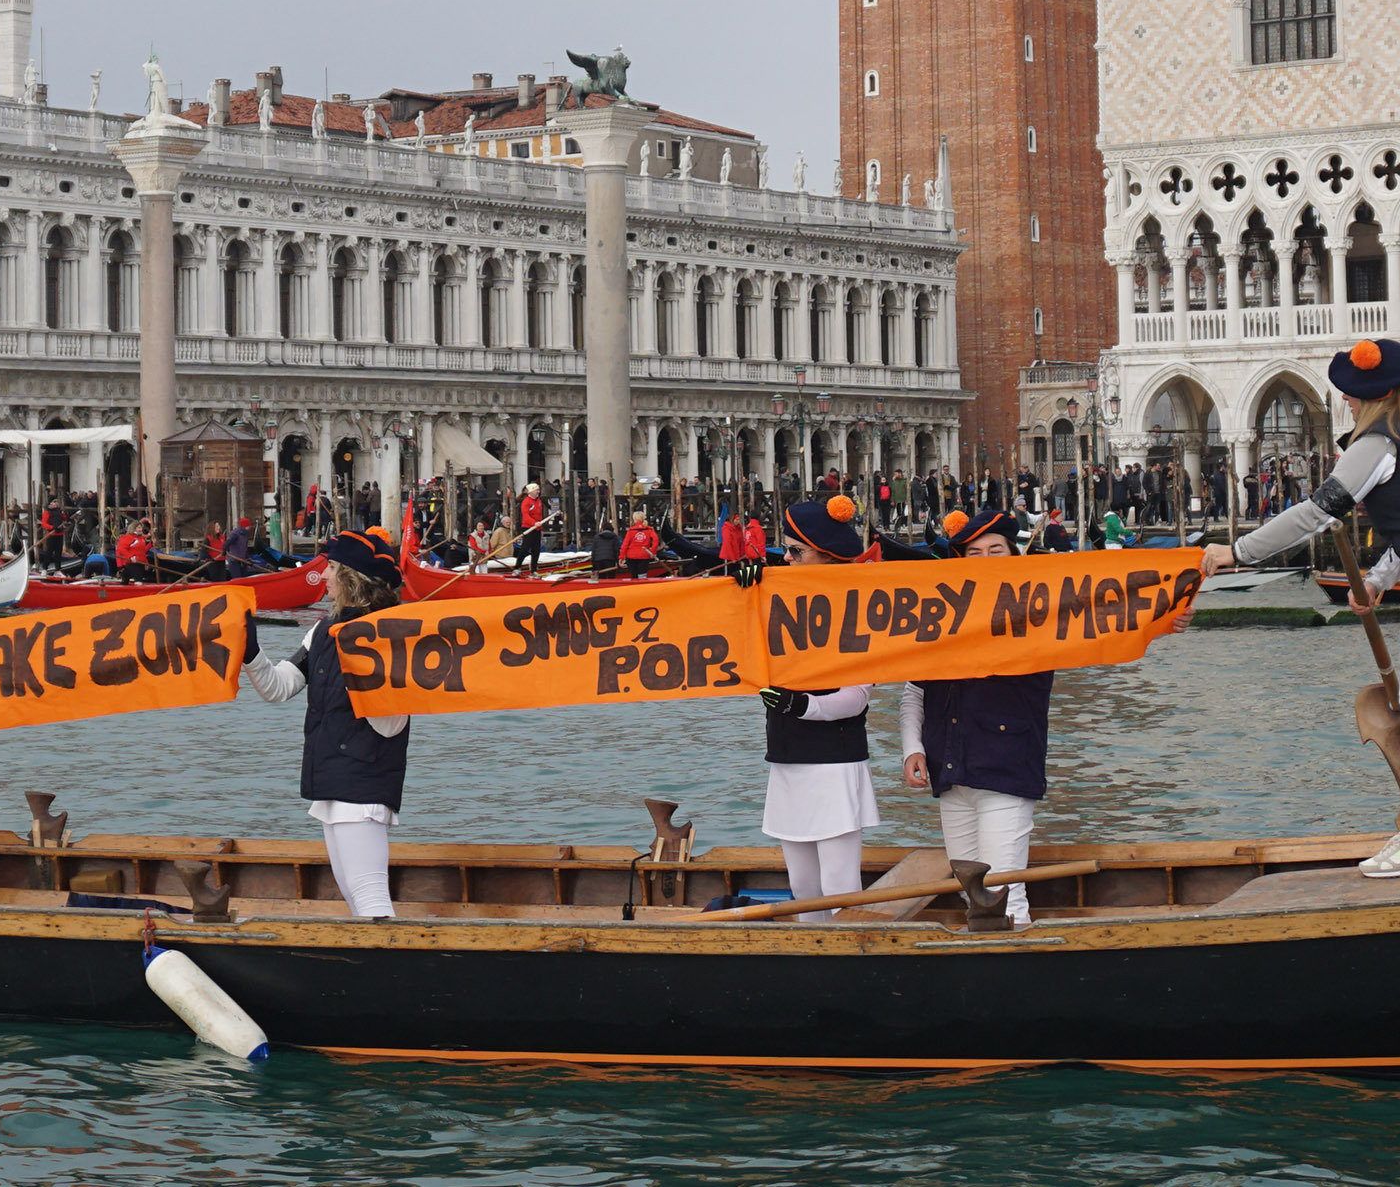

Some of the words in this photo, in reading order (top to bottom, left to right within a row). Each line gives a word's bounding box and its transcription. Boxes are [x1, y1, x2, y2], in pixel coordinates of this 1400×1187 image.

[90, 594, 230, 686] ZONE
[336, 615, 484, 692] STOP
[500, 596, 622, 666] SMOG
[768, 594, 831, 656] NO
[839, 580, 977, 653] LOBBY
[991, 581, 1049, 638] NO
